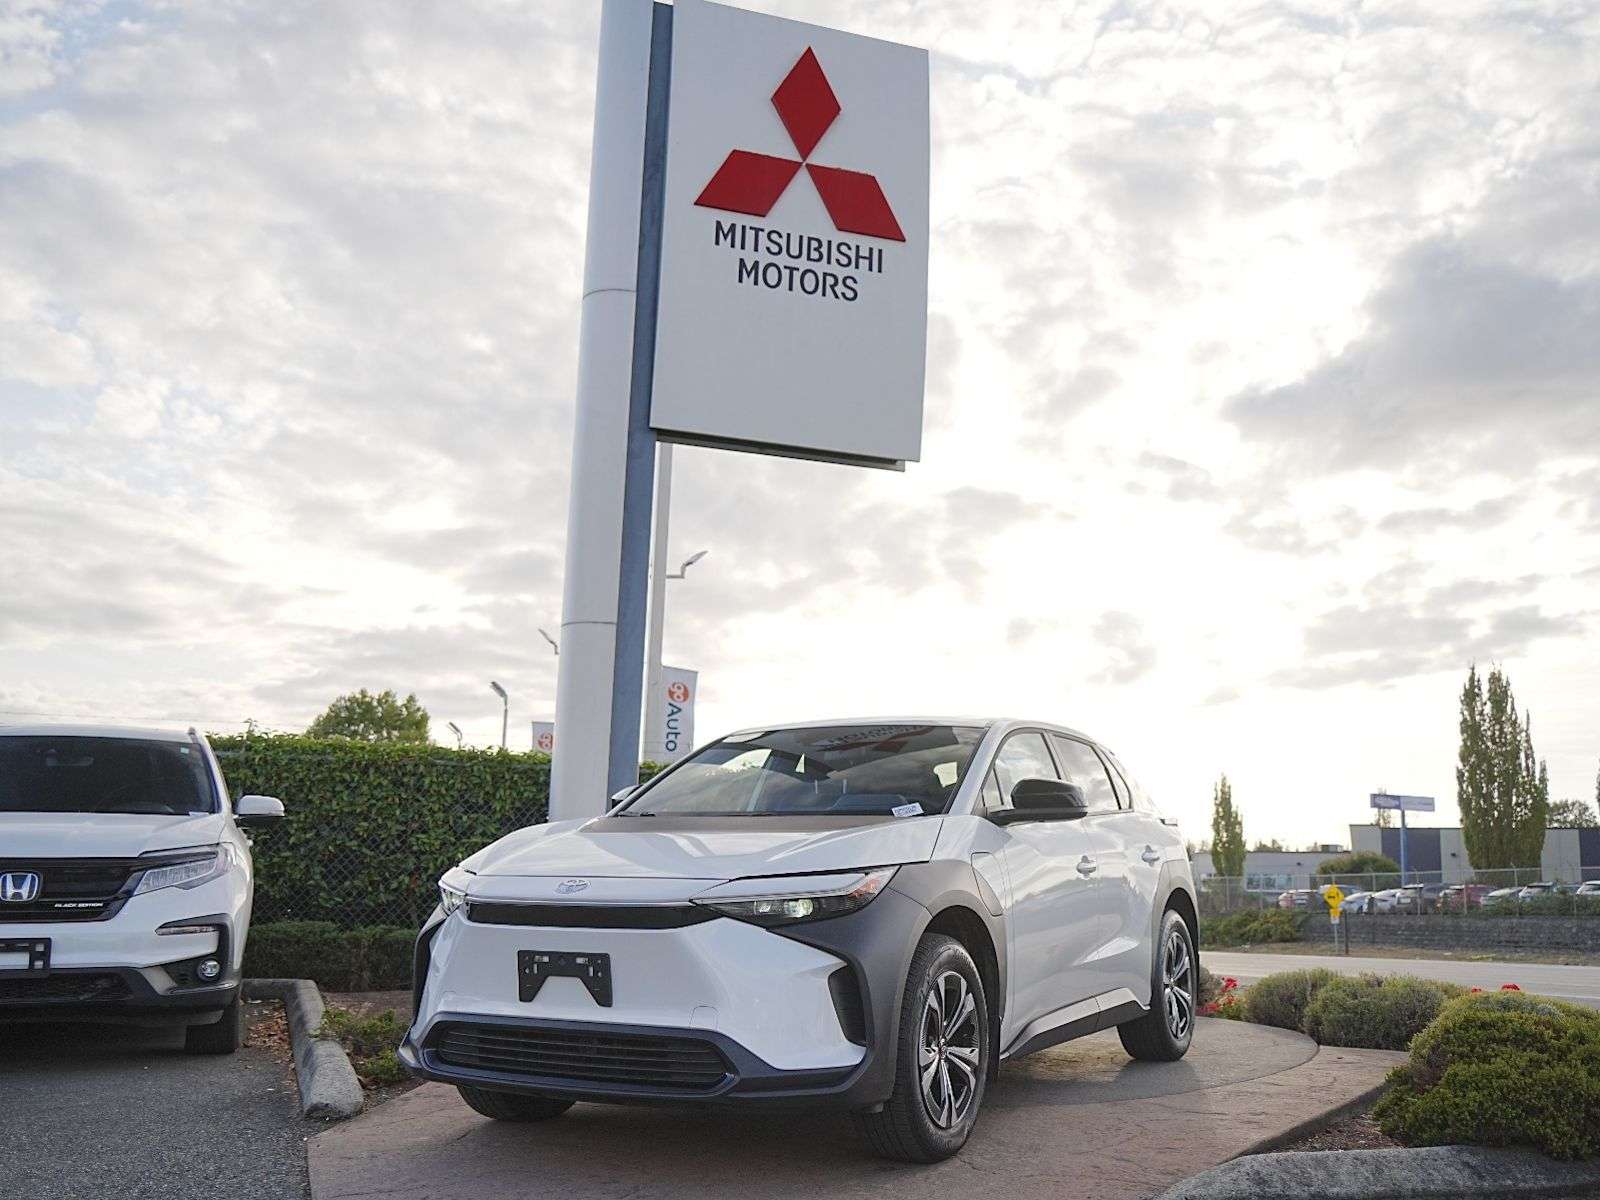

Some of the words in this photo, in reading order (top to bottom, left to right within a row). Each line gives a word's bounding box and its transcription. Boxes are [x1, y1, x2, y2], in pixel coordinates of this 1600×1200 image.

[714, 220, 882, 273] MITSUBISHI
[738, 258, 858, 301] MOTORS
[665, 703, 682, 752] Auto
